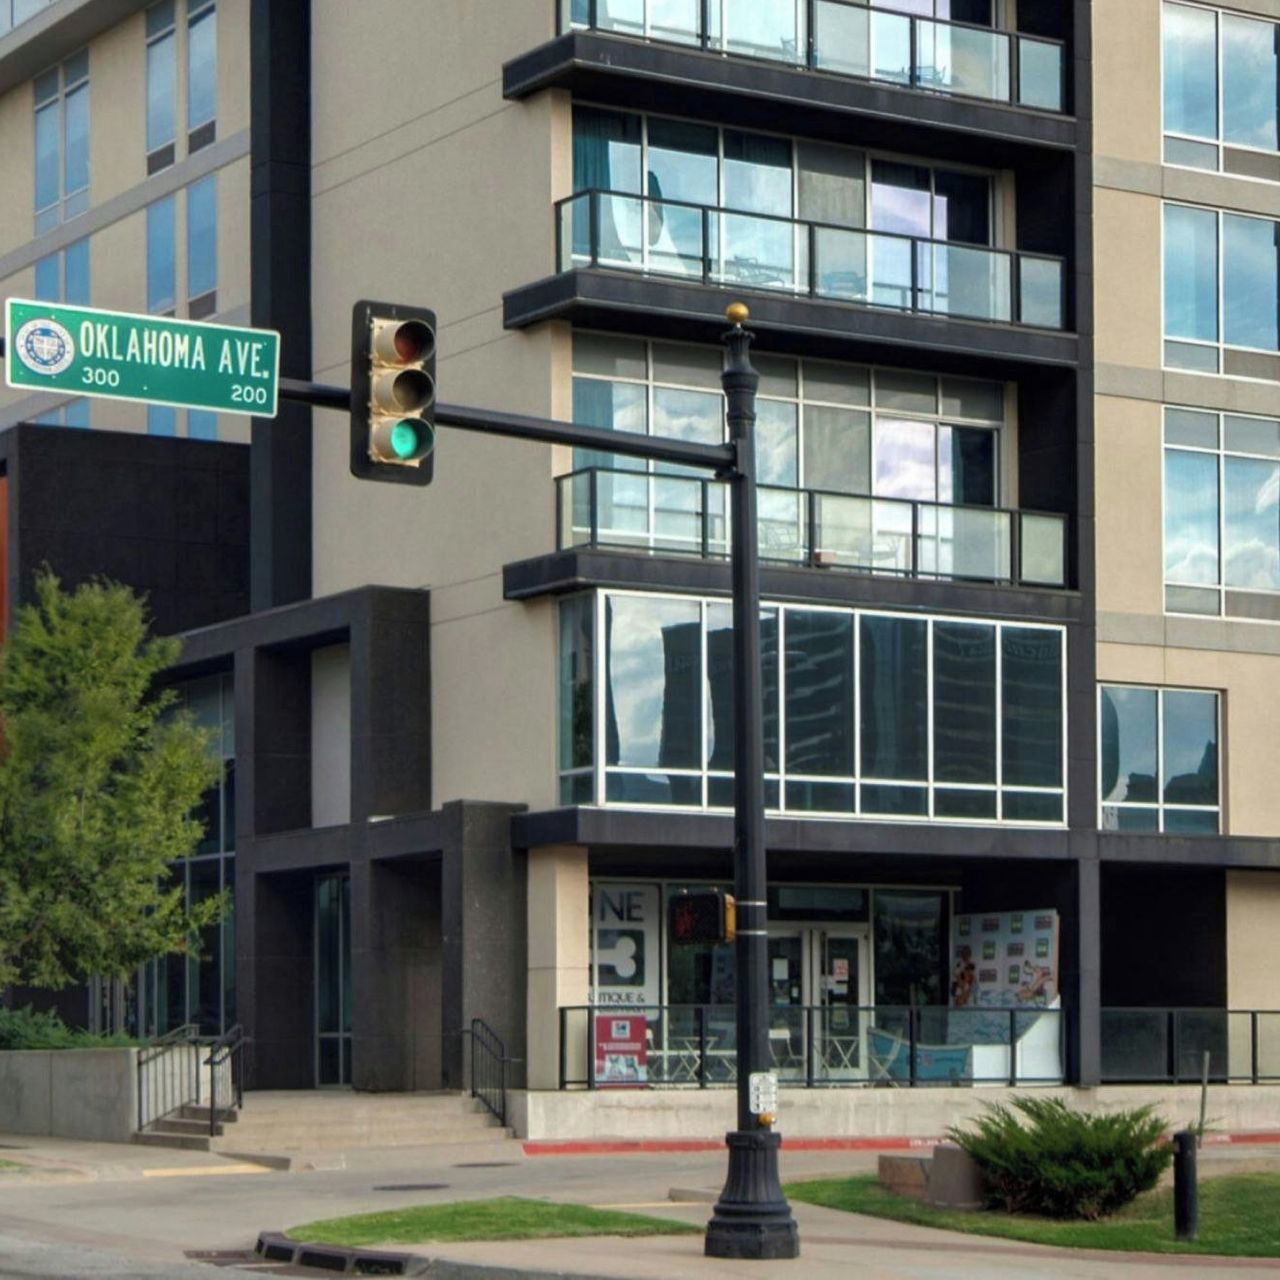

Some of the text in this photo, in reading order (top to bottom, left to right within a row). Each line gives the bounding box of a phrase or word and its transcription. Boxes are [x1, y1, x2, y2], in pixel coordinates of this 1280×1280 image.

[79, 320, 206, 371] OKLAHOMA
[218, 338, 270, 379] AVE.
[82, 366, 120, 388] 300
[230, 384, 267, 405] 200
